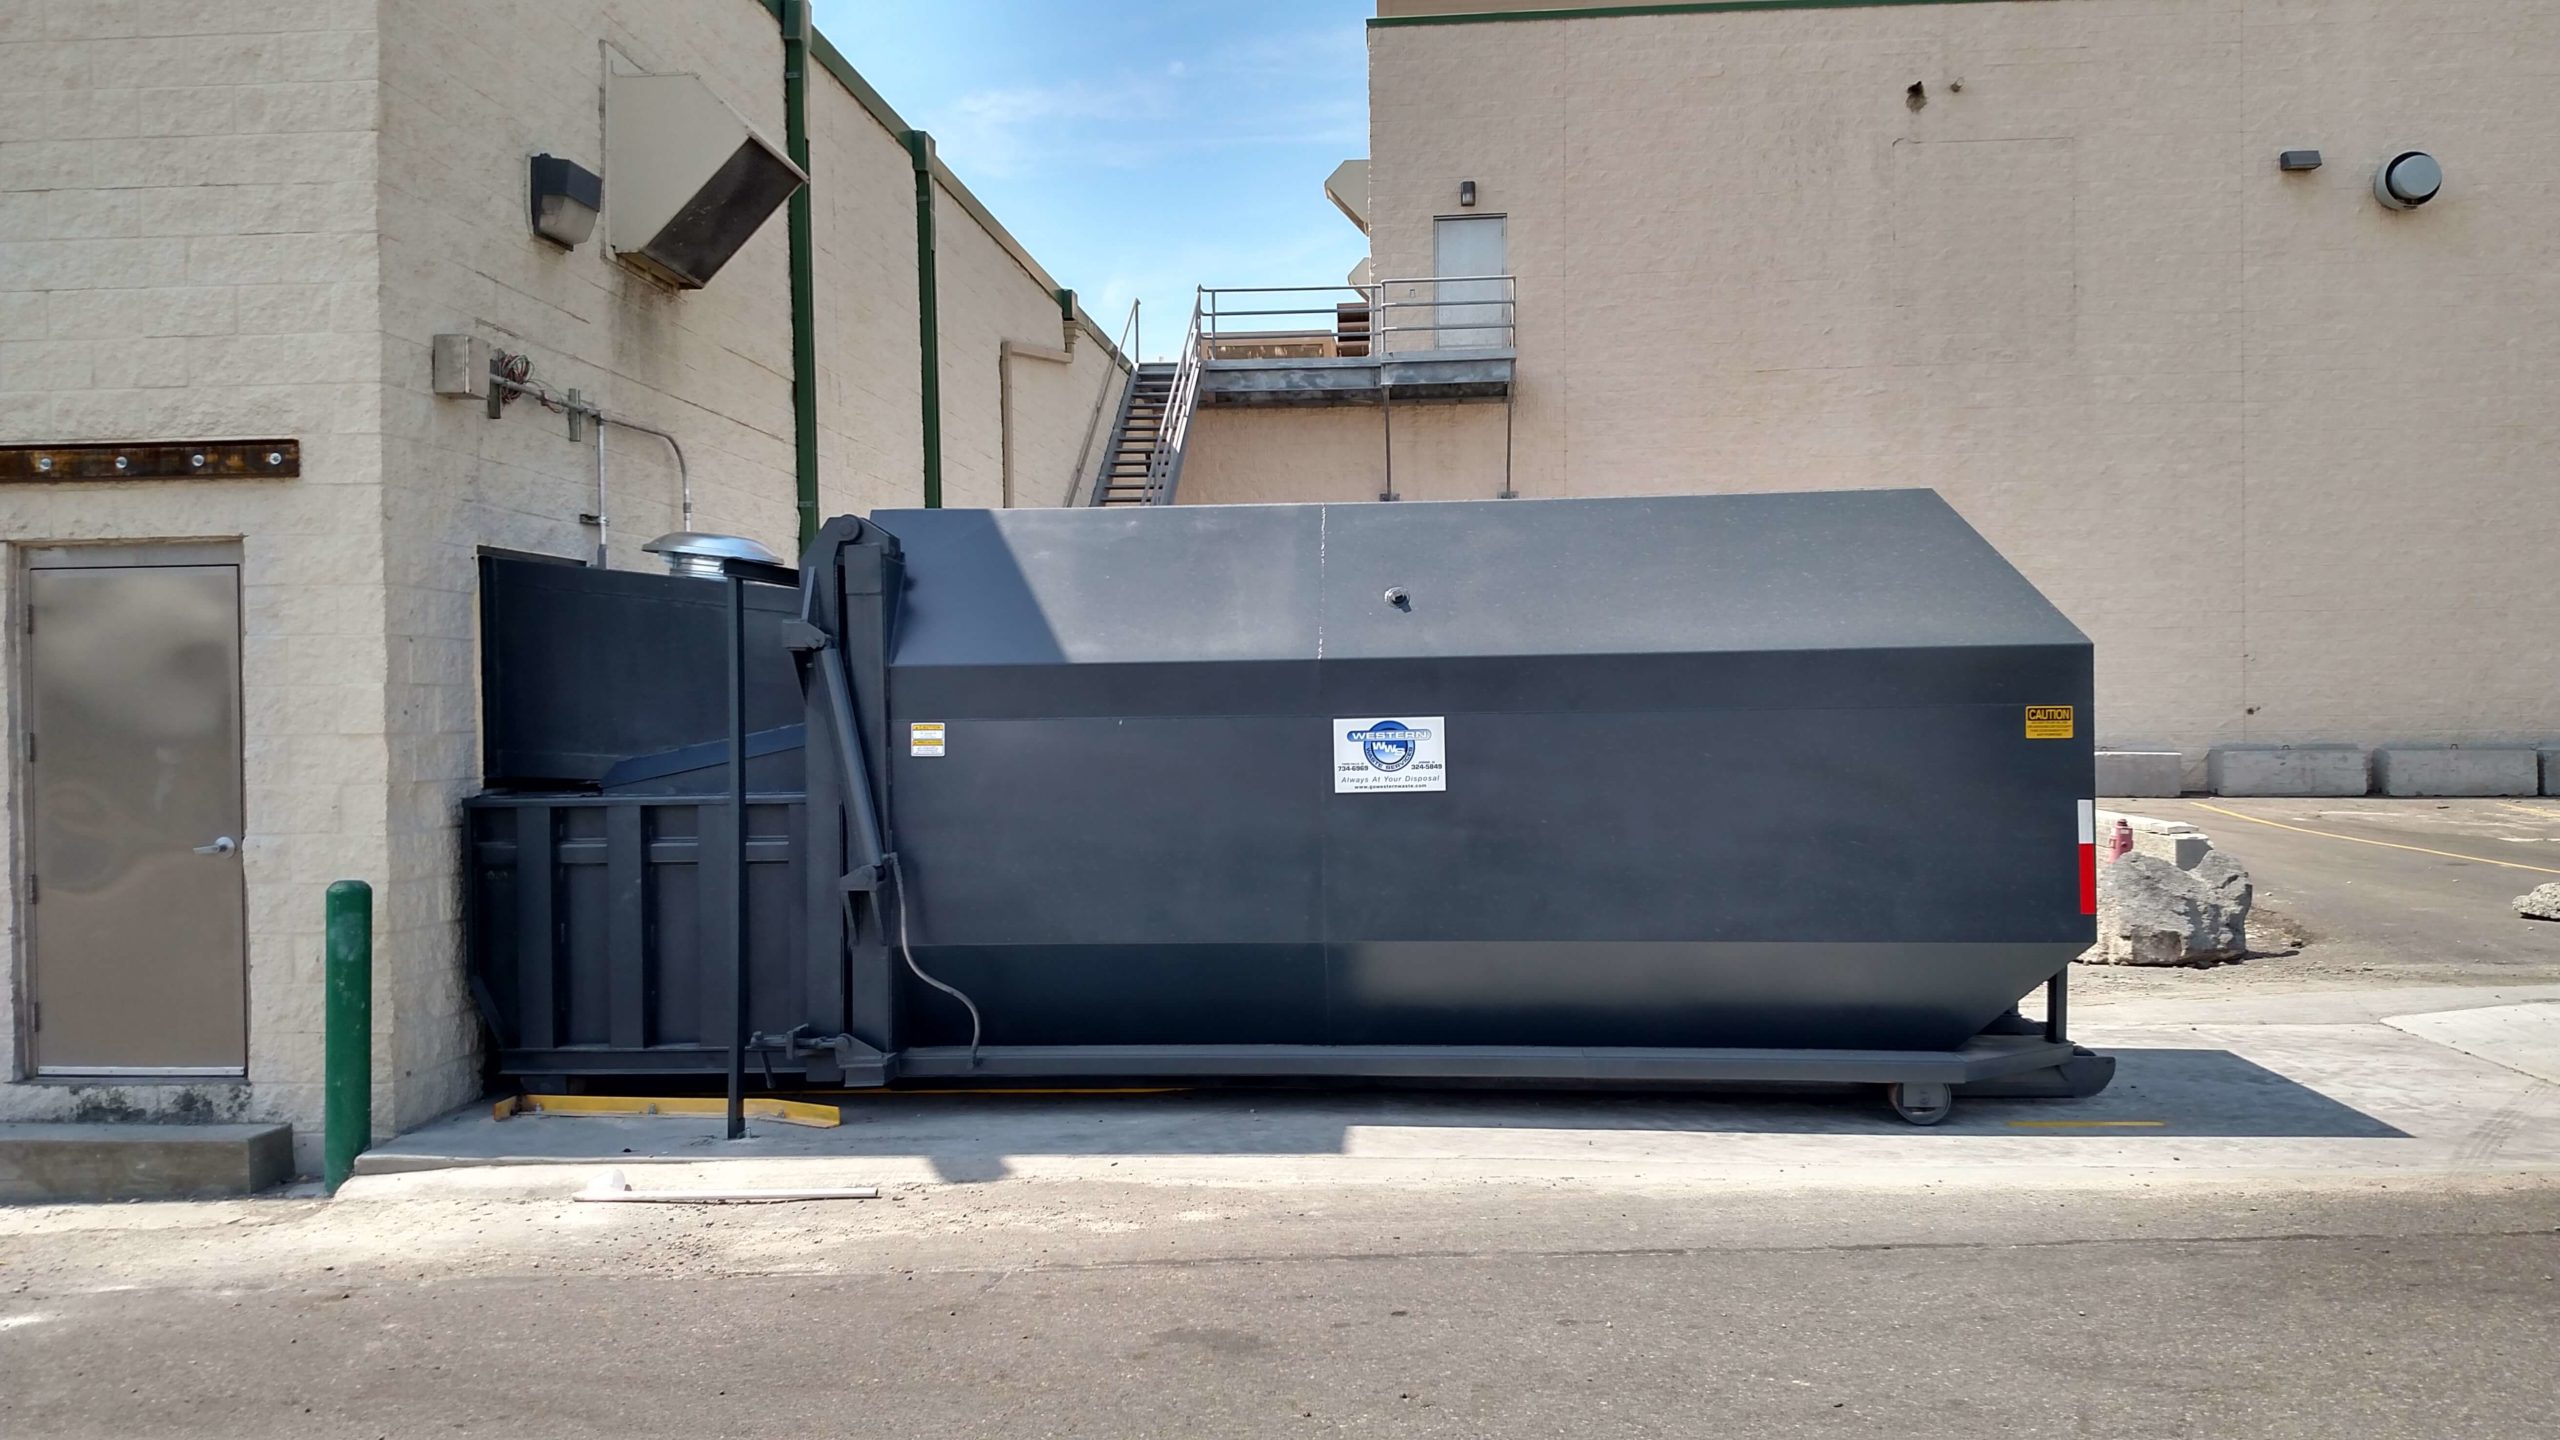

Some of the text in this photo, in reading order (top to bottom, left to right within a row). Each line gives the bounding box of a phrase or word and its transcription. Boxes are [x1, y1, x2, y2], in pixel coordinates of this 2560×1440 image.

[2029, 709, 2070, 720] CAUTION
[1352, 731, 1427, 740] WESTERN
[1372, 741, 1405, 756] WWS
[1366, 746, 1413, 770] WASTE SERVICES
[1341, 776, 1369, 784] Always
[1405, 775, 1440, 783] Disposal
